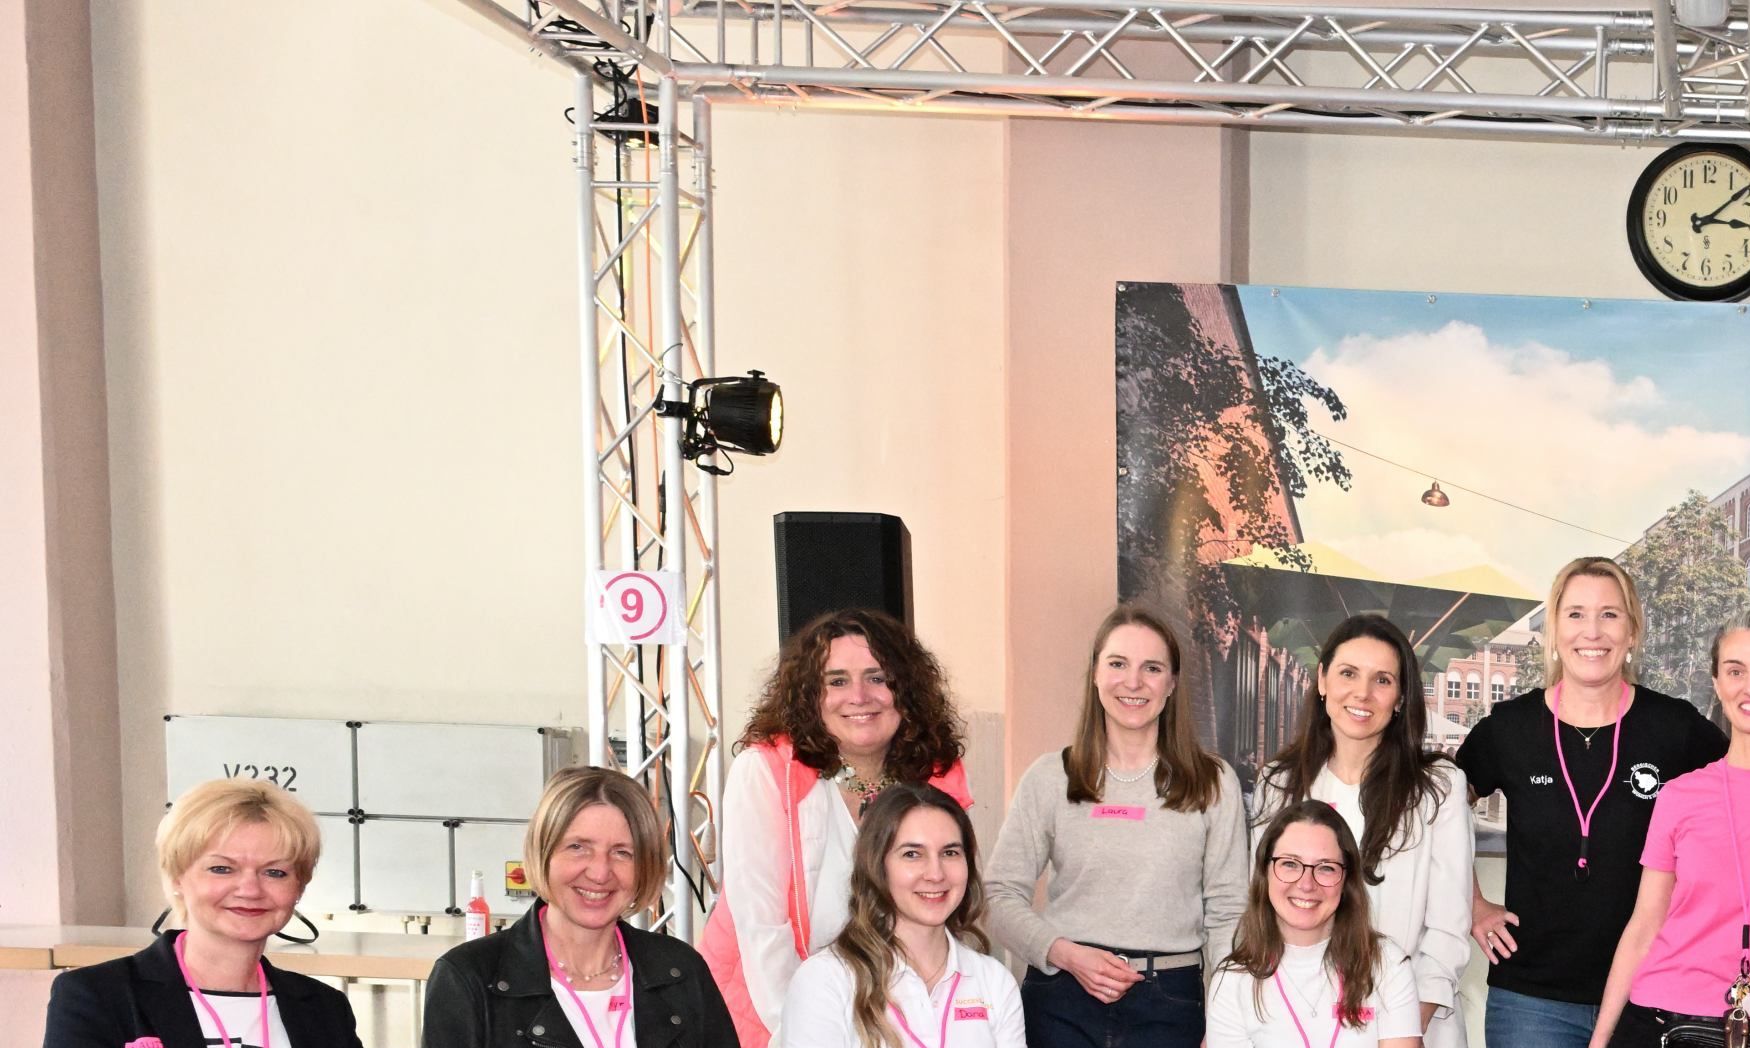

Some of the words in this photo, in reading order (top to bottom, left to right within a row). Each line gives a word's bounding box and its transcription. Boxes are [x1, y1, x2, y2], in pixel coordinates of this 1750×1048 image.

[1683, 169, 1694, 189] 11
[1703, 164, 1717, 184] 12
[1728, 171, 1734, 191] 1
[1663, 186, 1678, 206] 10
[1656, 209, 1667, 228] 9
[1663, 236, 1674, 254] 8
[1681, 251, 1691, 270] 7
[1701, 258, 1712, 277] 6
[1722, 253, 1733, 273] 5
[621, 588, 644, 623] 9
[1529, 774, 1554, 786] Katja
